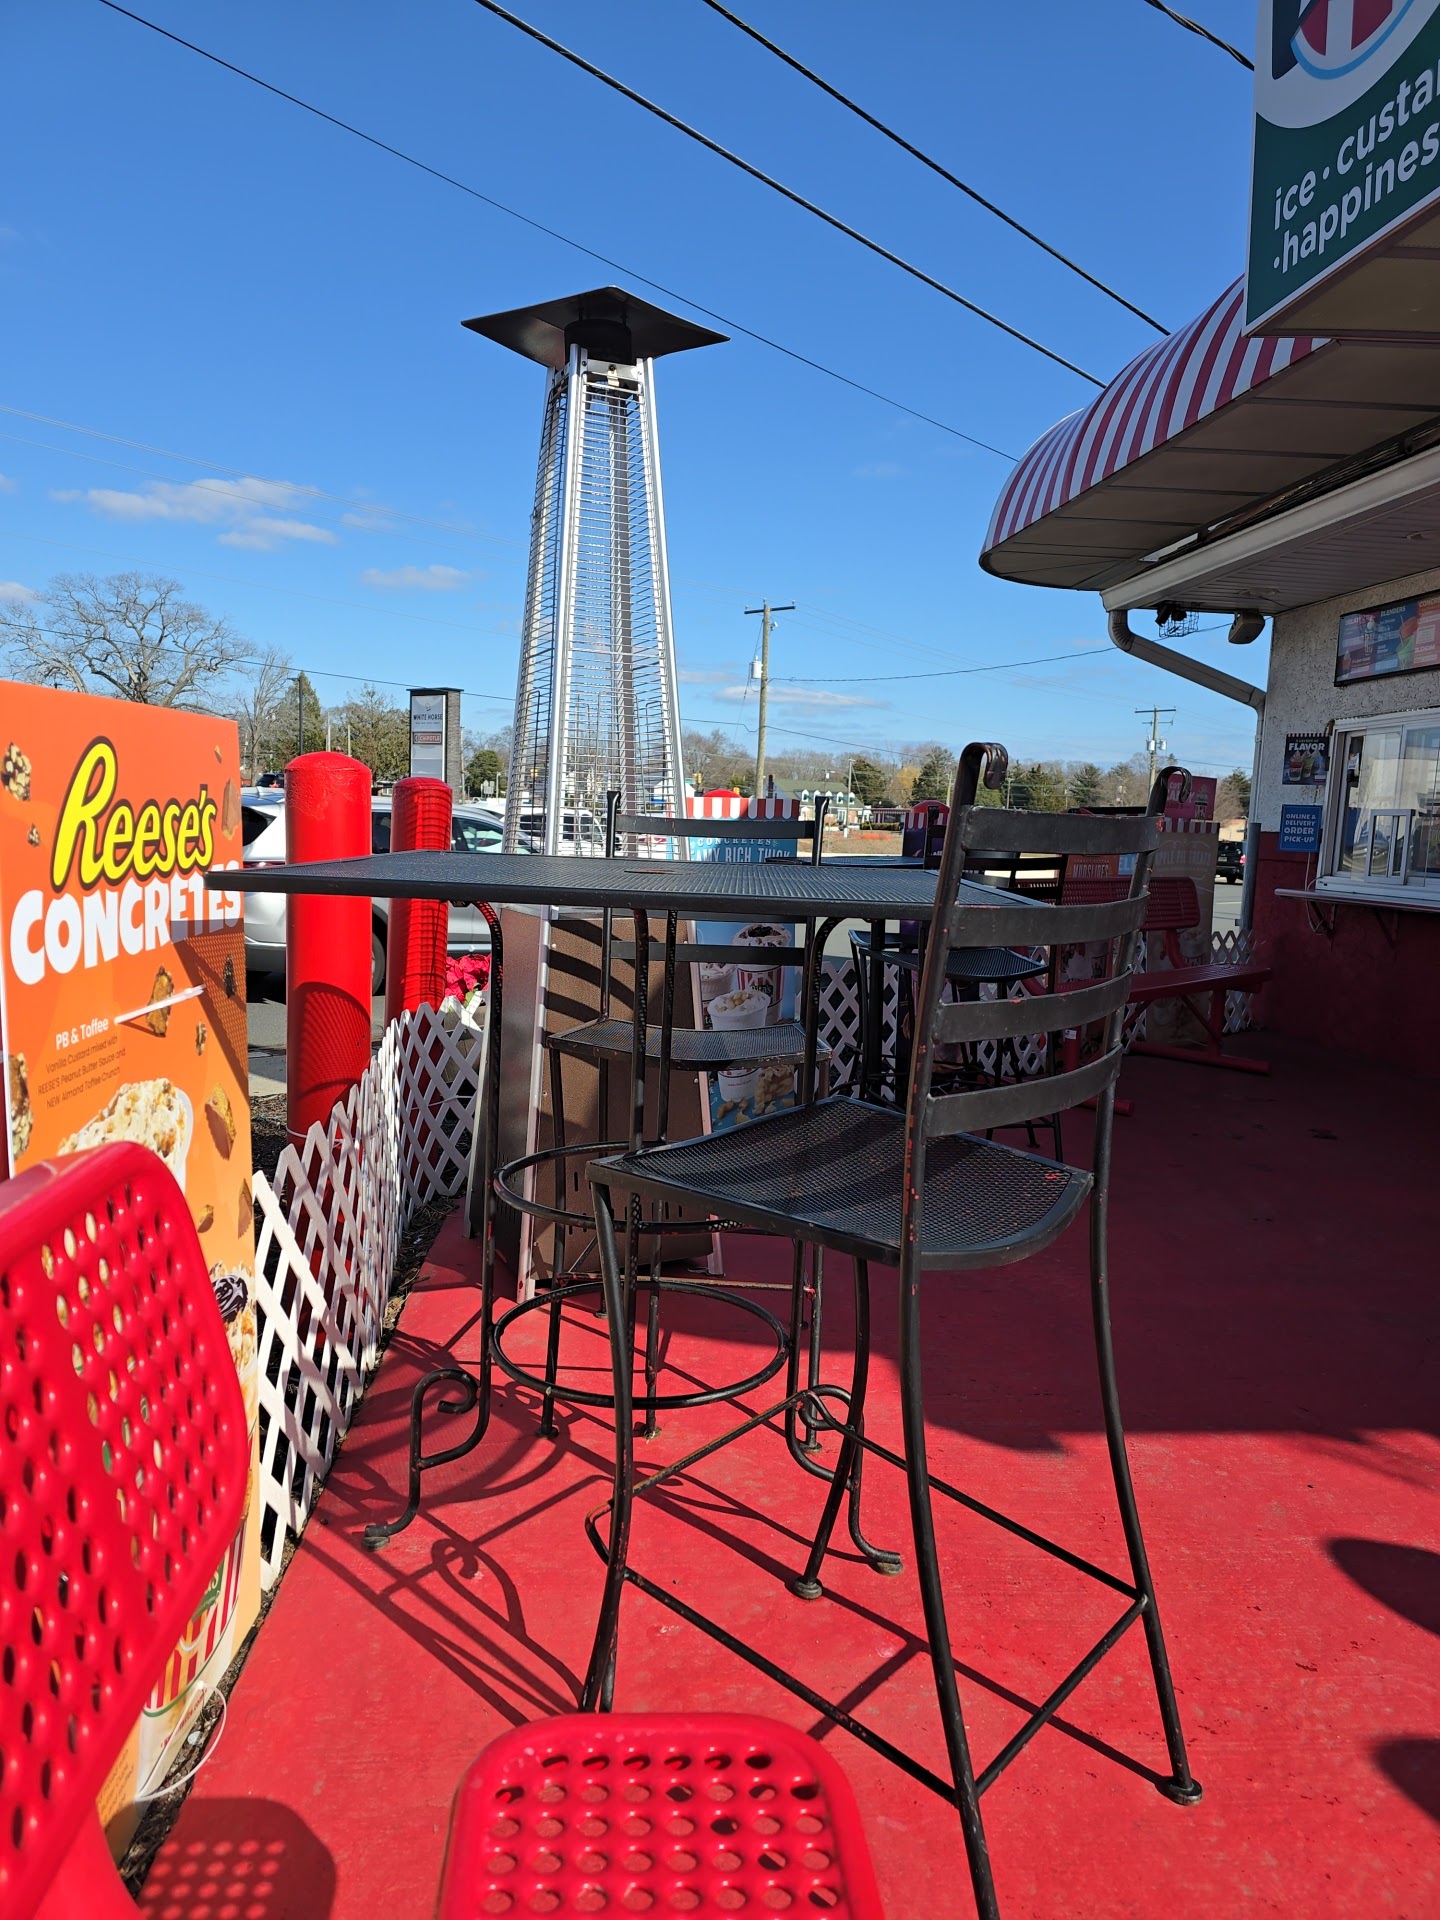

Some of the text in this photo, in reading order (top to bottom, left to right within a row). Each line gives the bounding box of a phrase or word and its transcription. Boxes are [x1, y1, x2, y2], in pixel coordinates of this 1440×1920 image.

[1274, 59, 1440, 230] ice custa
[1380, 606, 1406, 617] BLENDERS
[1288, 742, 1326, 751] FLAVOR
[51, 738, 217, 890] Reese's
[1284, 827, 1314, 835] ORDER
[725, 846, 752, 862] RICH
[55, 1017, 109, 1051] PB & Toffee
[38, 1048, 126, 1096] REESE'S Peanut Butter Sauce and
[46, 1034, 118, 1074] Vanilla Custard mixed with
[46, 1066, 121, 1109] NEW Almond Toffee Crunch
